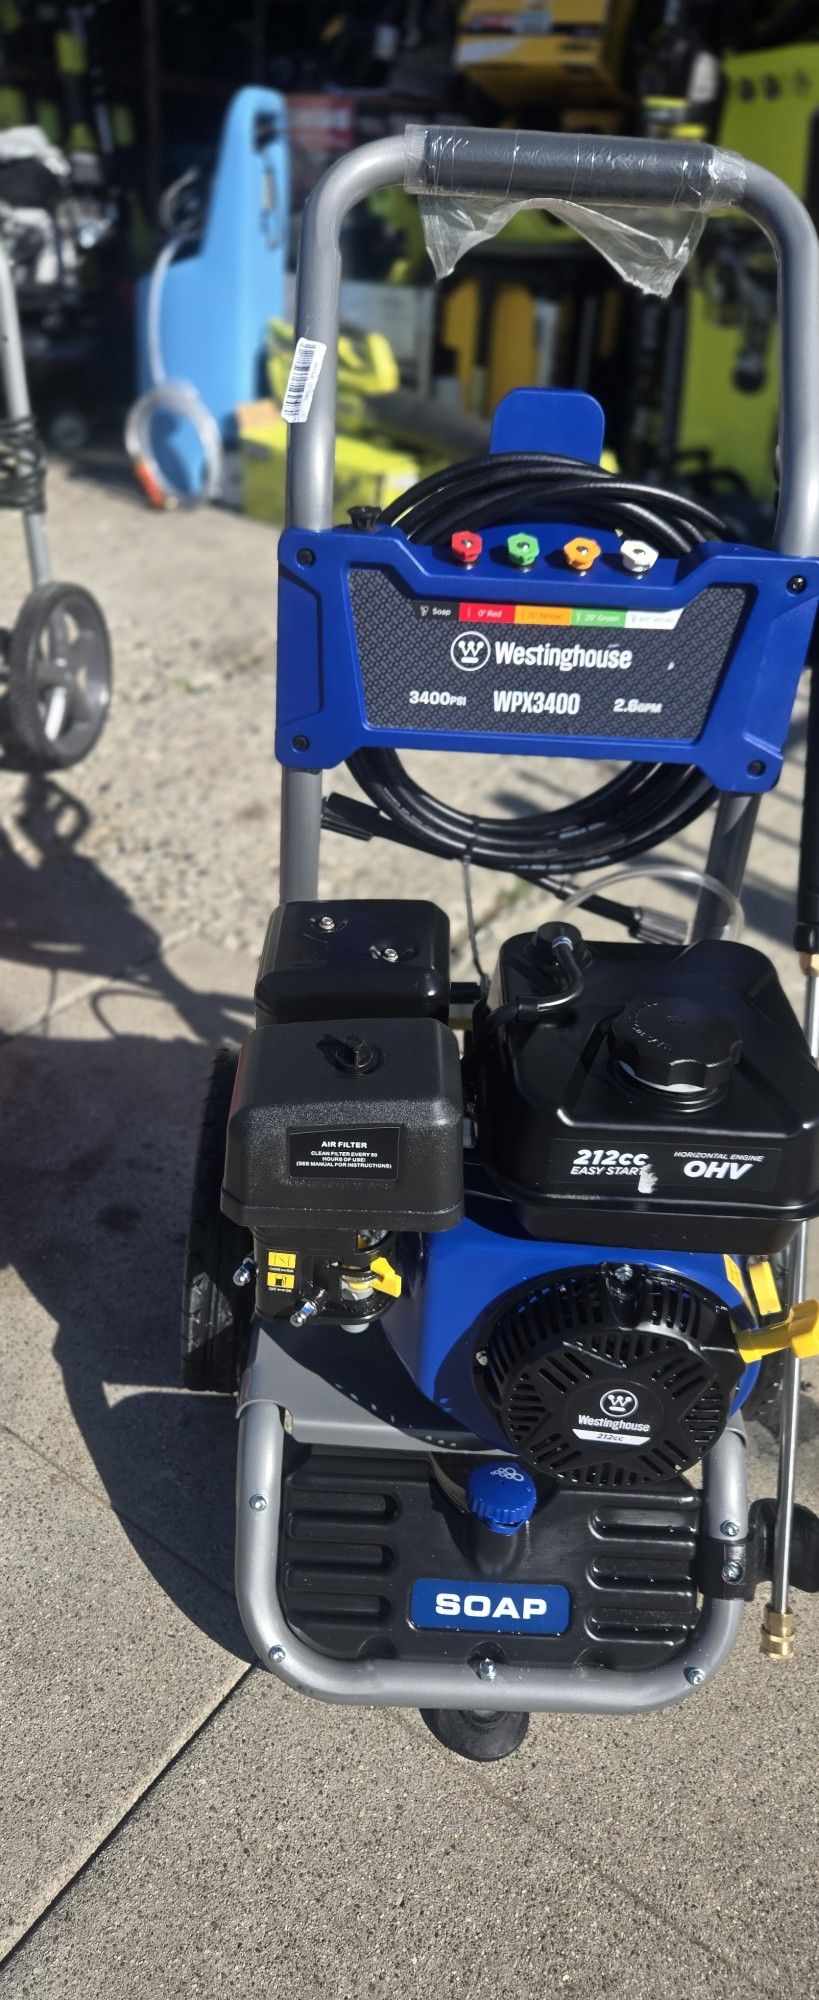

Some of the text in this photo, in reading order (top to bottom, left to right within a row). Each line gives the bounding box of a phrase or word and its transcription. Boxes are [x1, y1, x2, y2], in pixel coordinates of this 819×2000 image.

[432, 606, 452, 616] Soap
[487, 609, 502, 618] Red
[494, 641, 633, 672] Westinghouse
[493, 690, 580, 715] WPX3400
[337, 1141, 368, 1149] FILTER
[572, 1149, 650, 1166] 212cc
[673, 1151, 766, 1162] HORIZONTAL ENGINE
[570, 1165, 605, 1175] EASY
[683, 1160, 754, 1180] OHV
[578, 1414, 651, 1432] Westinghouse
[596, 1433, 625, 1442] 212cc
[435, 1592, 548, 1620] SOAP
